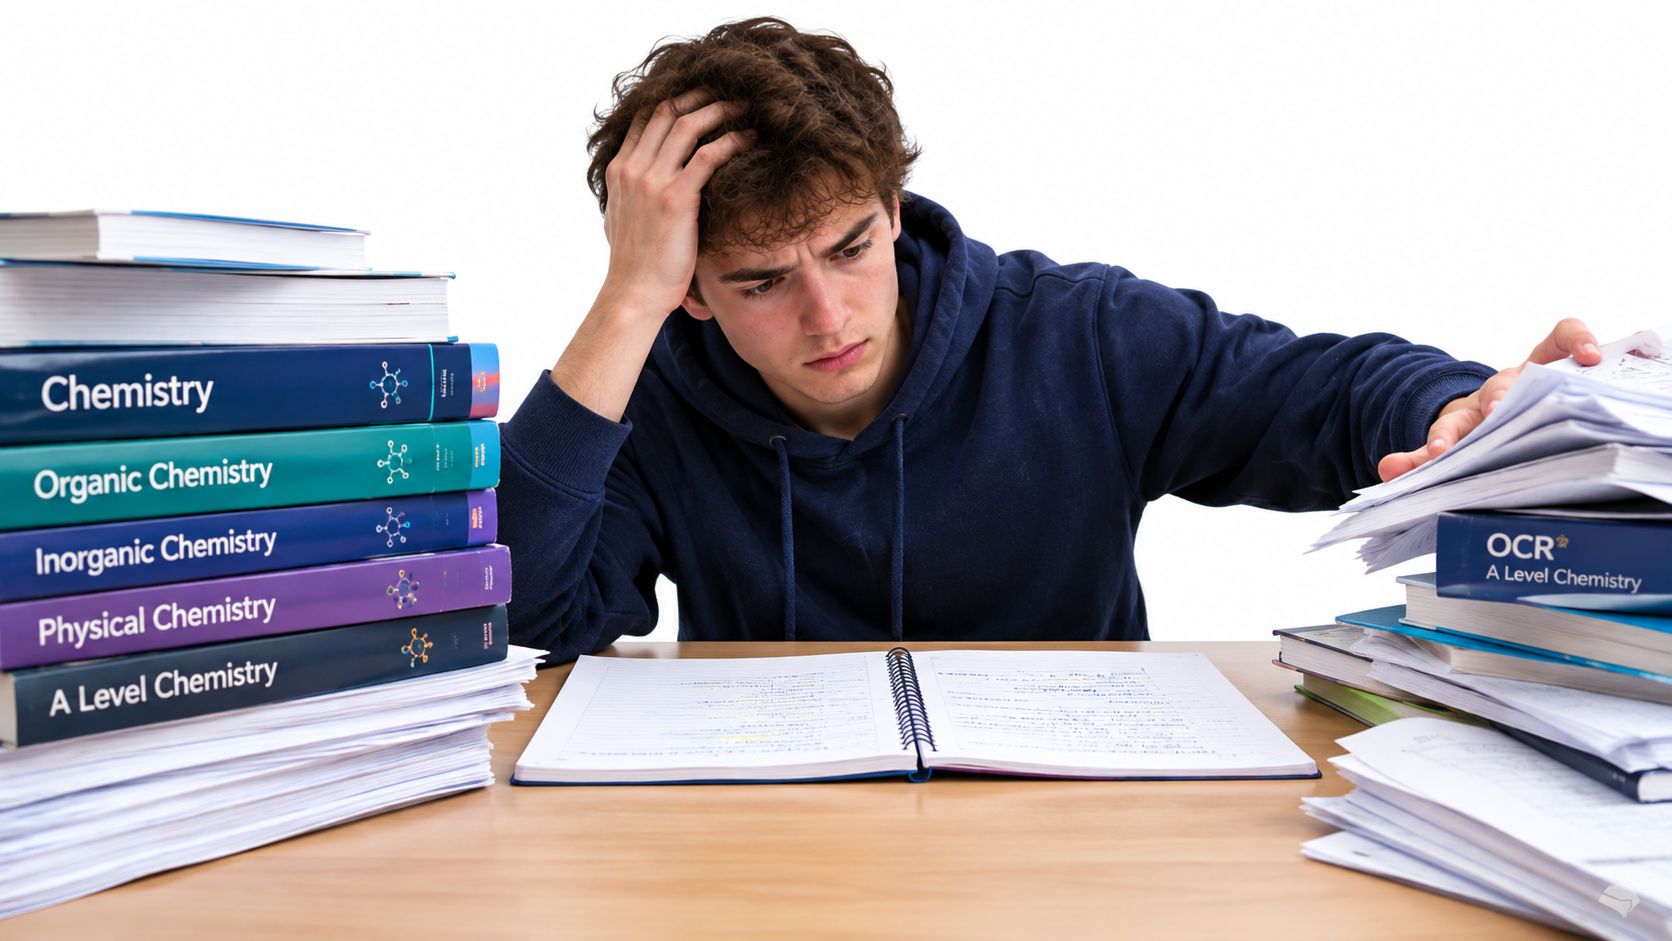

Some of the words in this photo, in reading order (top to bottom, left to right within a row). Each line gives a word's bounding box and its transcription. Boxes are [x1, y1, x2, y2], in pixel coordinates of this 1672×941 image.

[41, 374, 214, 414] Chemistry
[34, 464, 143, 504] Organic
[149, 459, 273, 490] Chemistry
[35, 538, 155, 577] Inorganic
[160, 529, 277, 561] Chemistry
[1487, 532, 1554, 560] OCR
[1486, 564, 1500, 580] A
[1504, 565, 1549, 583] Level
[1553, 569, 1642, 593] Chemistry
[38, 605, 146, 649] Physical
[152, 597, 277, 631] Chemistry
[49, 688, 72, 717] A
[78, 674, 147, 712] Level
[154, 660, 278, 699] Chemistry
